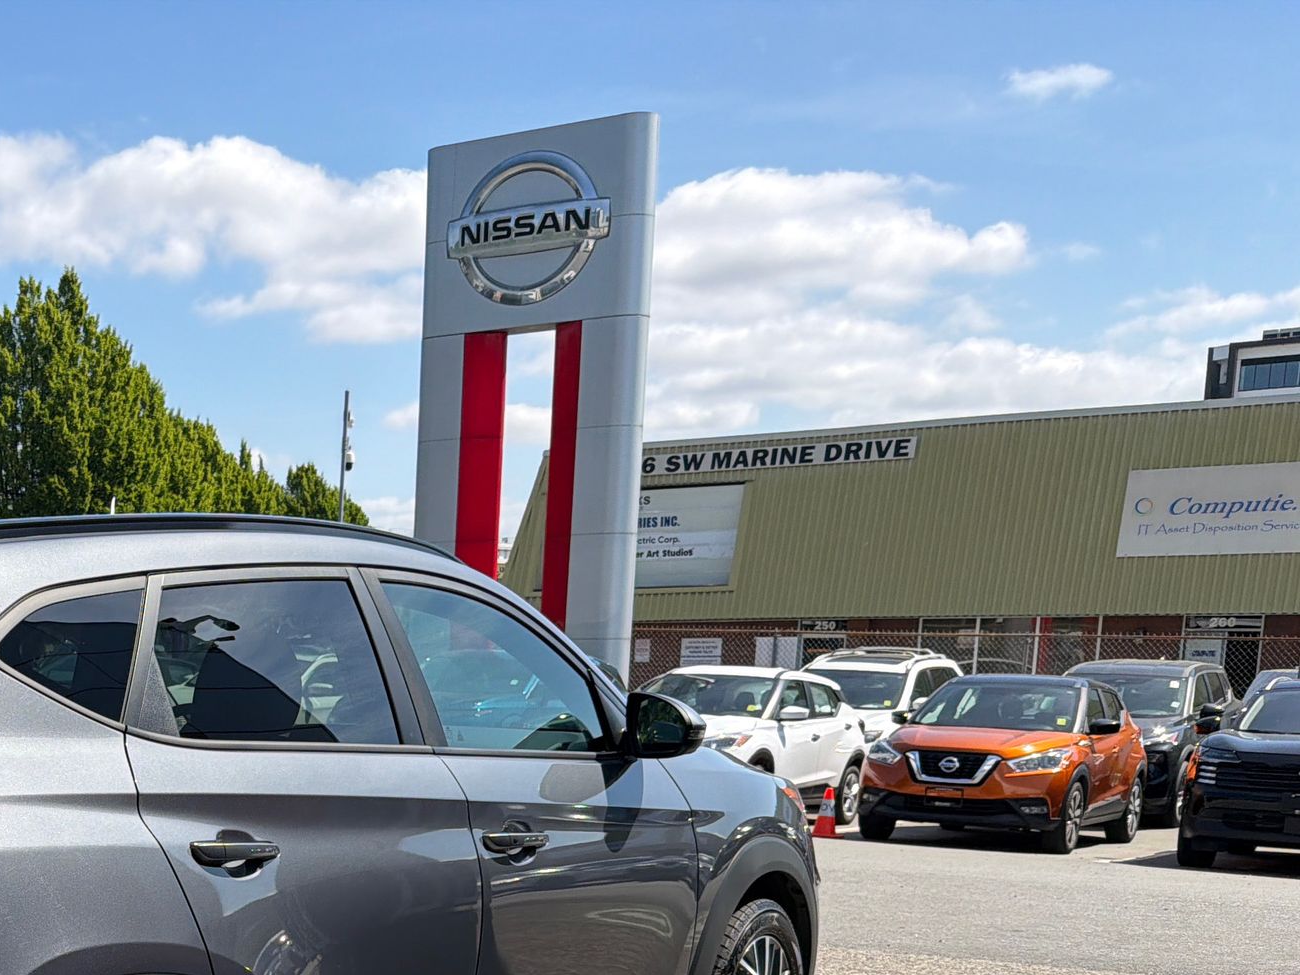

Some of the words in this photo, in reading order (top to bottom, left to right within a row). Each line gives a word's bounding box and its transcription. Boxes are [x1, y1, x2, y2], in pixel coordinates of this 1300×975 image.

[460, 207, 591, 247] NISSAN
[641, 456, 656, 474] 6
[665, 453, 706, 473] SW
[710, 445, 816, 470] MARINE
[823, 438, 912, 463] DRIVE
[660, 515, 681, 528] INC.
[1137, 523, 1152, 536] IT
[1155, 523, 1190, 535] Asset
[1192, 522, 1258, 535] Disposition
[657, 535, 681, 546] Corp.
[646, 550, 659, 558] Art
[662, 547, 693, 558] Studios
[814, 620, 836, 631] 250
[1209, 617, 1236, 628] 260
